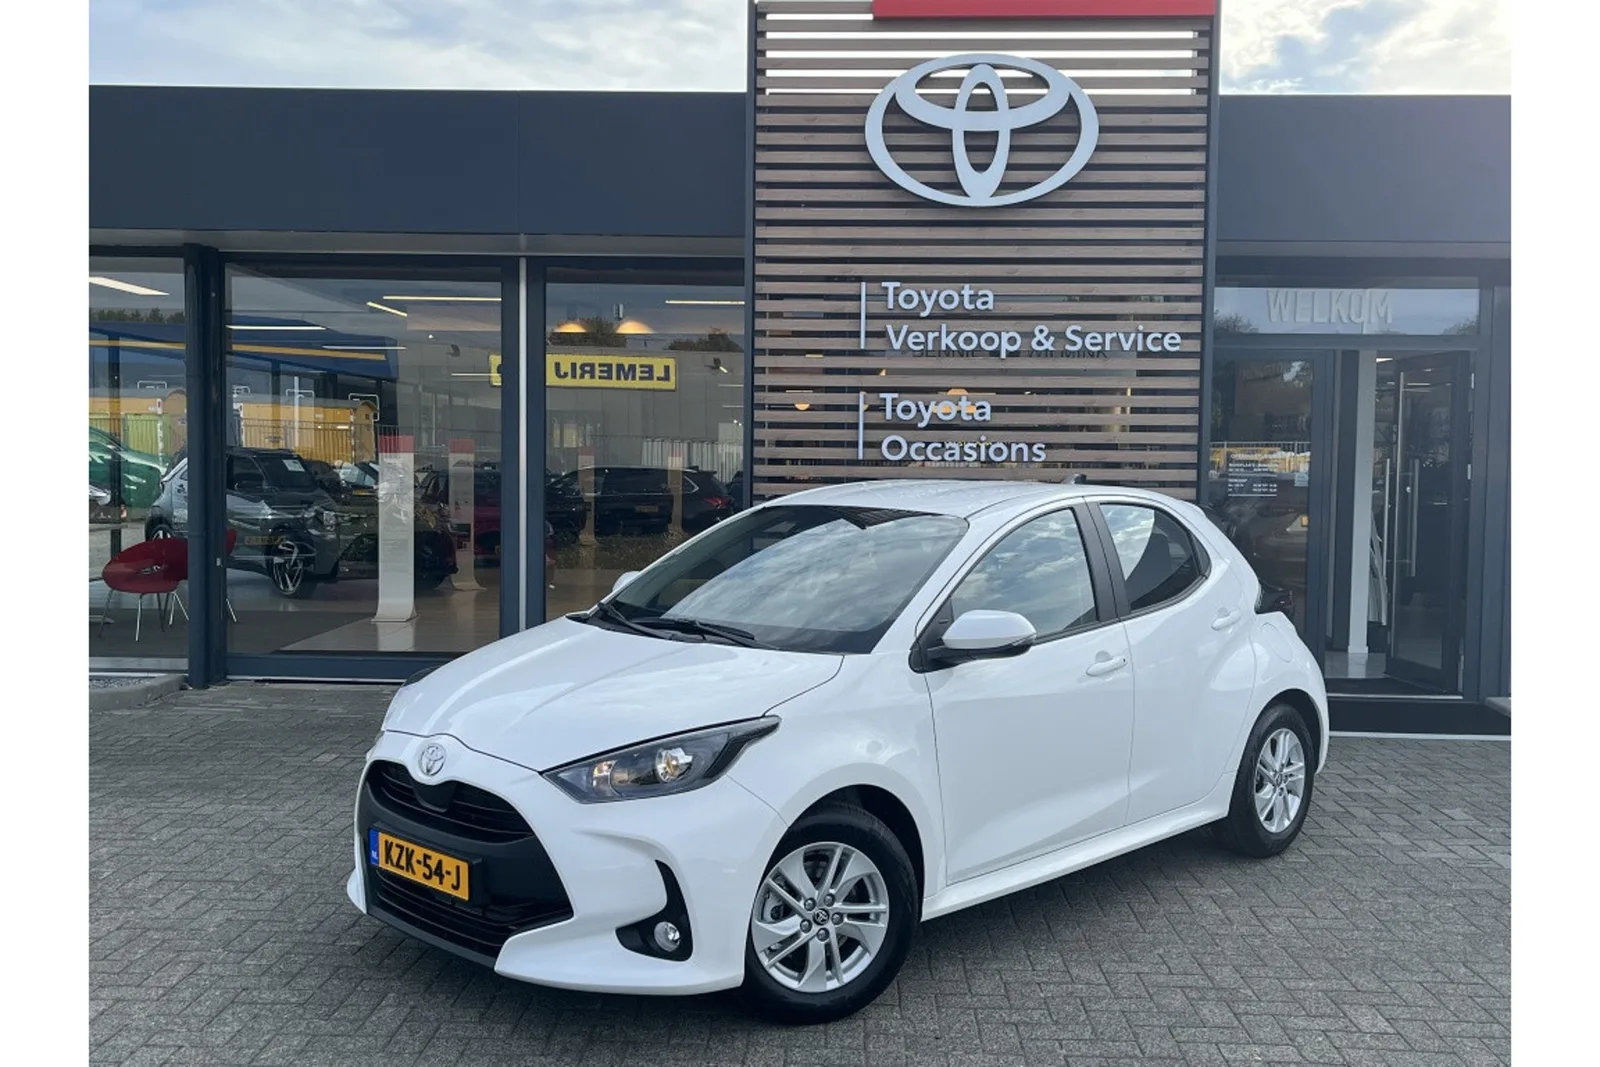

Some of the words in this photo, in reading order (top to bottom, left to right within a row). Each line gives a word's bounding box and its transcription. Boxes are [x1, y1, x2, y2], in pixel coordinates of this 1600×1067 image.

[881, 282, 995, 317] Toyota
[1266, 289, 1393, 324] WELKOM
[886, 324, 1022, 358] Verkoop
[1031, 326, 1055, 352] &
[1065, 325, 1181, 353] Service
[880, 392, 991, 428] Toyota
[881, 434, 1047, 463] Occasions
[384, 839, 461, 891] KZK-54-J
